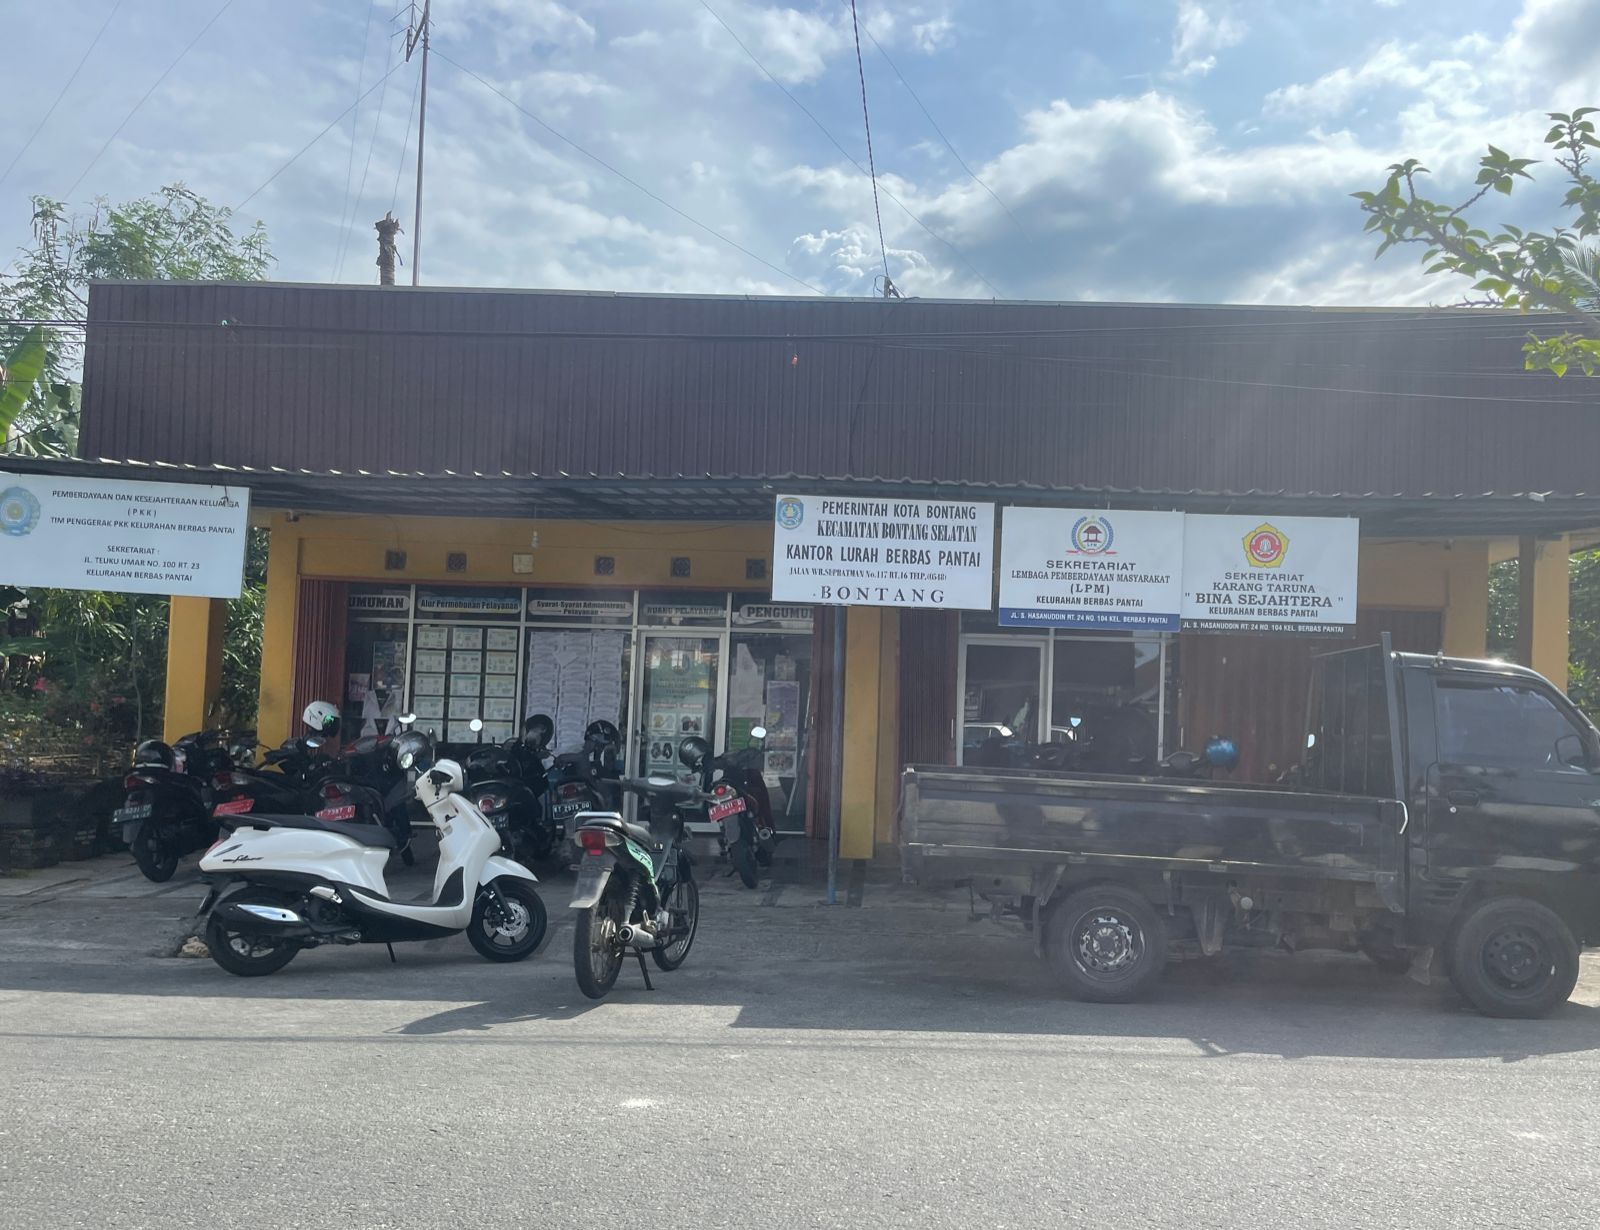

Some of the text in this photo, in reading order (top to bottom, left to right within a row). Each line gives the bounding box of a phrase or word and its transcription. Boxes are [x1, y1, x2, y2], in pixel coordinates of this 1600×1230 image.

[52, 490, 114, 500] PEMBERDAYAAN
[115, 493, 132, 502] DAN
[134, 495, 197, 505] KESEJAHTERAAN
[822, 500, 977, 520] PEMERINTAH KOTA BONTANG
[50, 516, 235, 534] TIM PENGGERAK PKK KELURAHAN BERBAS PANTAI
[817, 519, 977, 543] KECAMATAN BONTANG SELATAN
[786, 544, 981, 567] KANTOR LURAH BERBAS PANTAI
[95, 556, 120, 565] TEUKU
[121, 558, 145, 567] UMAR
[162, 560, 176, 569] 100
[191, 562, 200, 570] 23
[1046, 560, 1136, 571] SEKRETARIAT
[86, 568, 193, 582] KELURAHAN BERBAS PANTAI
[789, 567, 810, 575] JALAN
[1011, 570, 1170, 584] LEMBAGA PEMBERDAYAAN MASYARAKAT
[1225, 572, 1304, 582] SEKRETARIAT
[1070, 583, 1110, 595] (LPM)
[1213, 582, 1316, 593] KARANG TARUNA
[821, 586, 944, 603] BONTANG
[1195, 593, 1233, 604] BINA
[1238, 594, 1332, 607] SEJAHTERA
[421, 600, 435, 608] Alur
[1036, 596, 1143, 607] KELURAHAN BERBAS PANTAI
[1027, 612, 1065, 620] HASANUDDIN
[1123, 616, 1146, 624] BERBAS
[1147, 617, 1168, 625] PANTAI
[1209, 606, 1318, 618] KELURAHAN BERBAS PANTAI
[1200, 622, 1239, 630] HASANUDDIN
[1298, 625, 1321, 633] BERBAS
